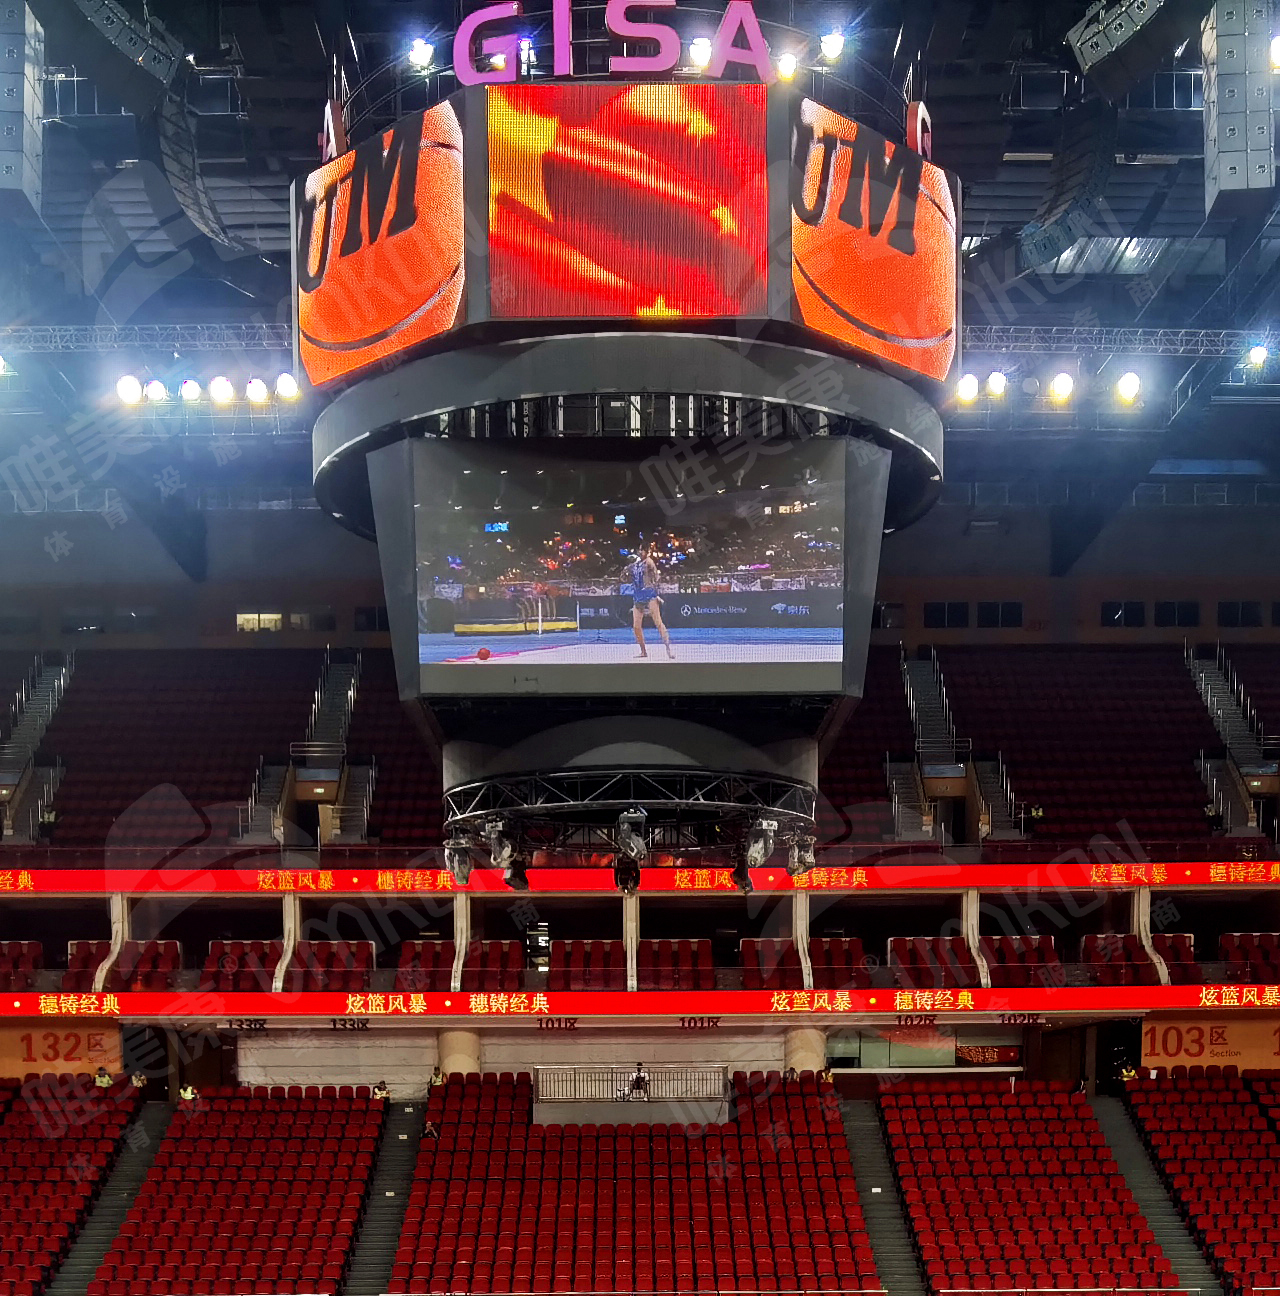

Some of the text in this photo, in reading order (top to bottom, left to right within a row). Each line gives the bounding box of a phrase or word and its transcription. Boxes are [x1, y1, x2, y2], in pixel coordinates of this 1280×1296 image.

[453, 0, 777, 84] GISA
[39, 994, 120, 1014] 穗铸经典
[346, 994, 550, 1014] 炫篮风暴 穗铸经典
[770, 990, 974, 1011] 炫篮风暴 穗铸经典
[1199, 986, 1280, 1007] 炫篮风暴
[20, 1032, 104, 1063] 132区
[1143, 1025, 1228, 1057] 103区
